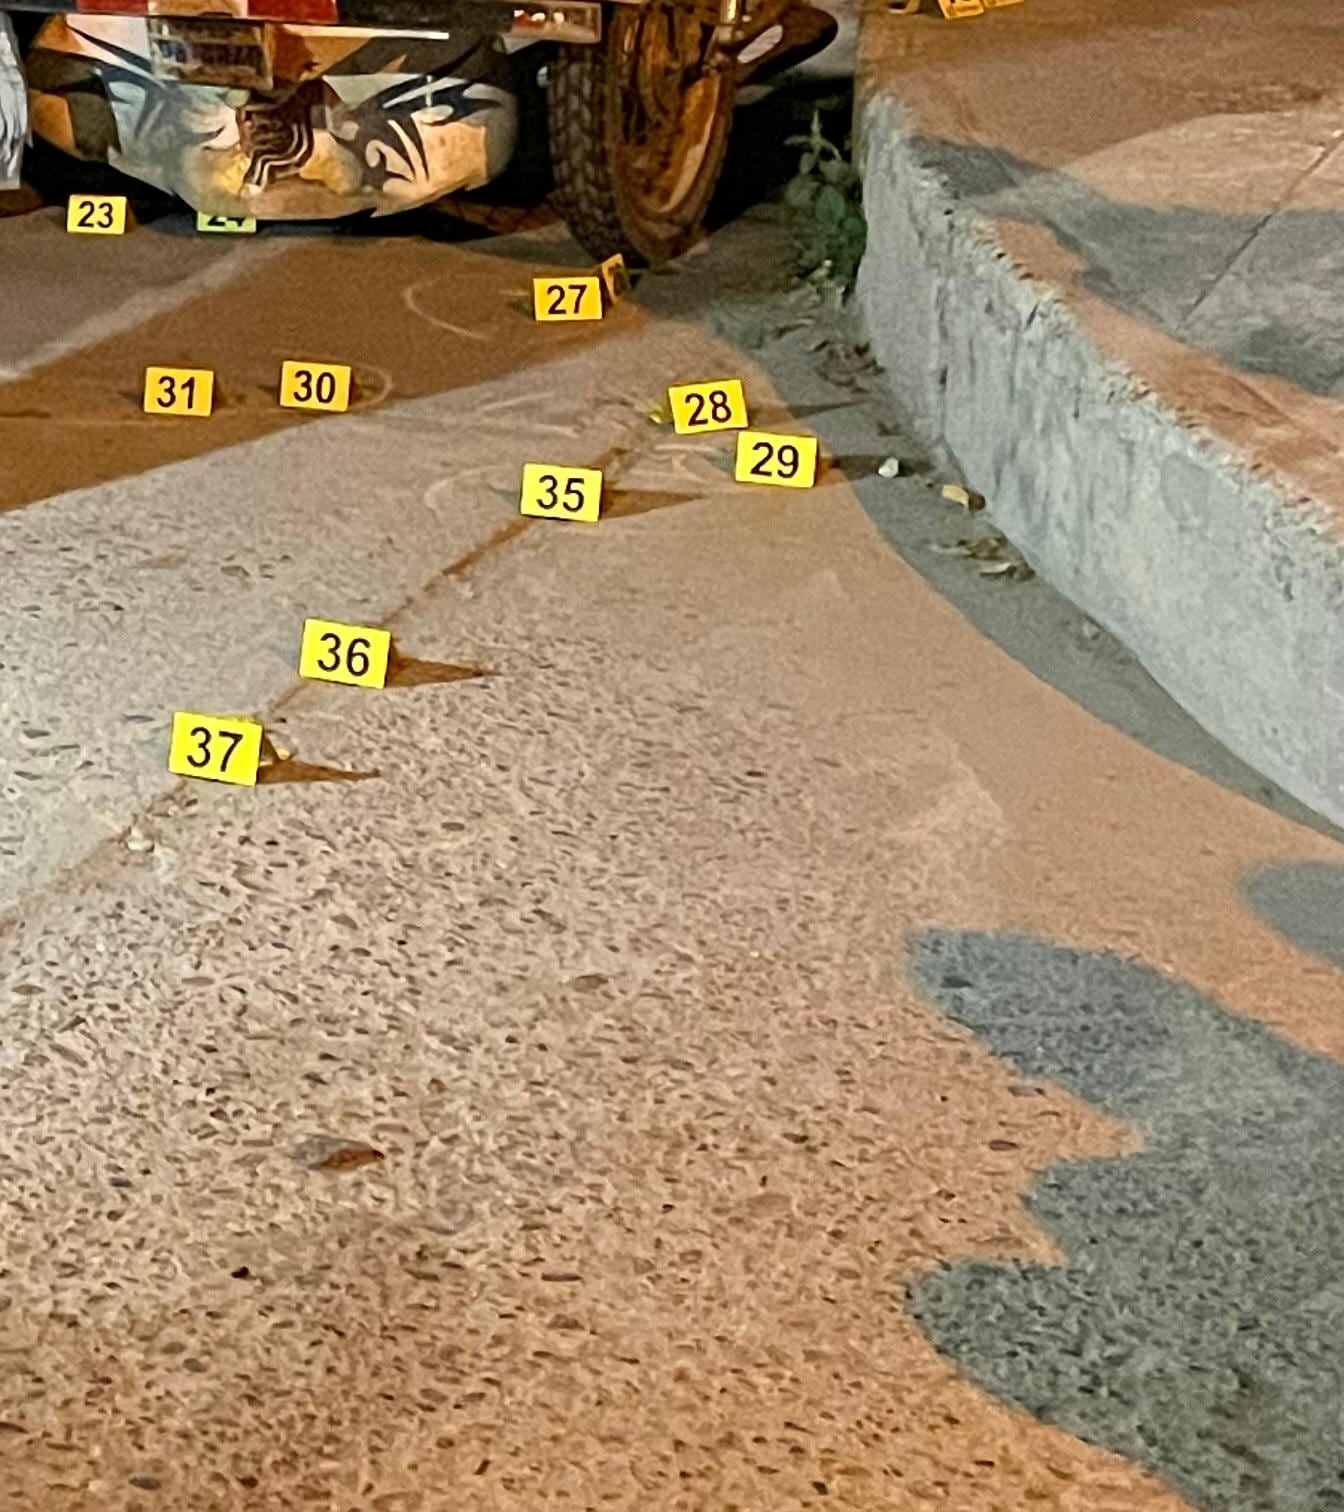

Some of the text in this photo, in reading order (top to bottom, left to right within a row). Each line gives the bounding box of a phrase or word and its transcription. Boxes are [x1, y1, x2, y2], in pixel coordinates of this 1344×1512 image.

[77, 200, 114, 229] 23
[546, 284, 587, 315] 27
[157, 375, 195, 409] 31
[293, 370, 336, 404] 30
[685, 390, 732, 427] 28
[750, 442, 799, 479] 29
[536, 474, 585, 513] 35
[317, 632, 371, 677] 36
[187, 726, 243, 772] 37
